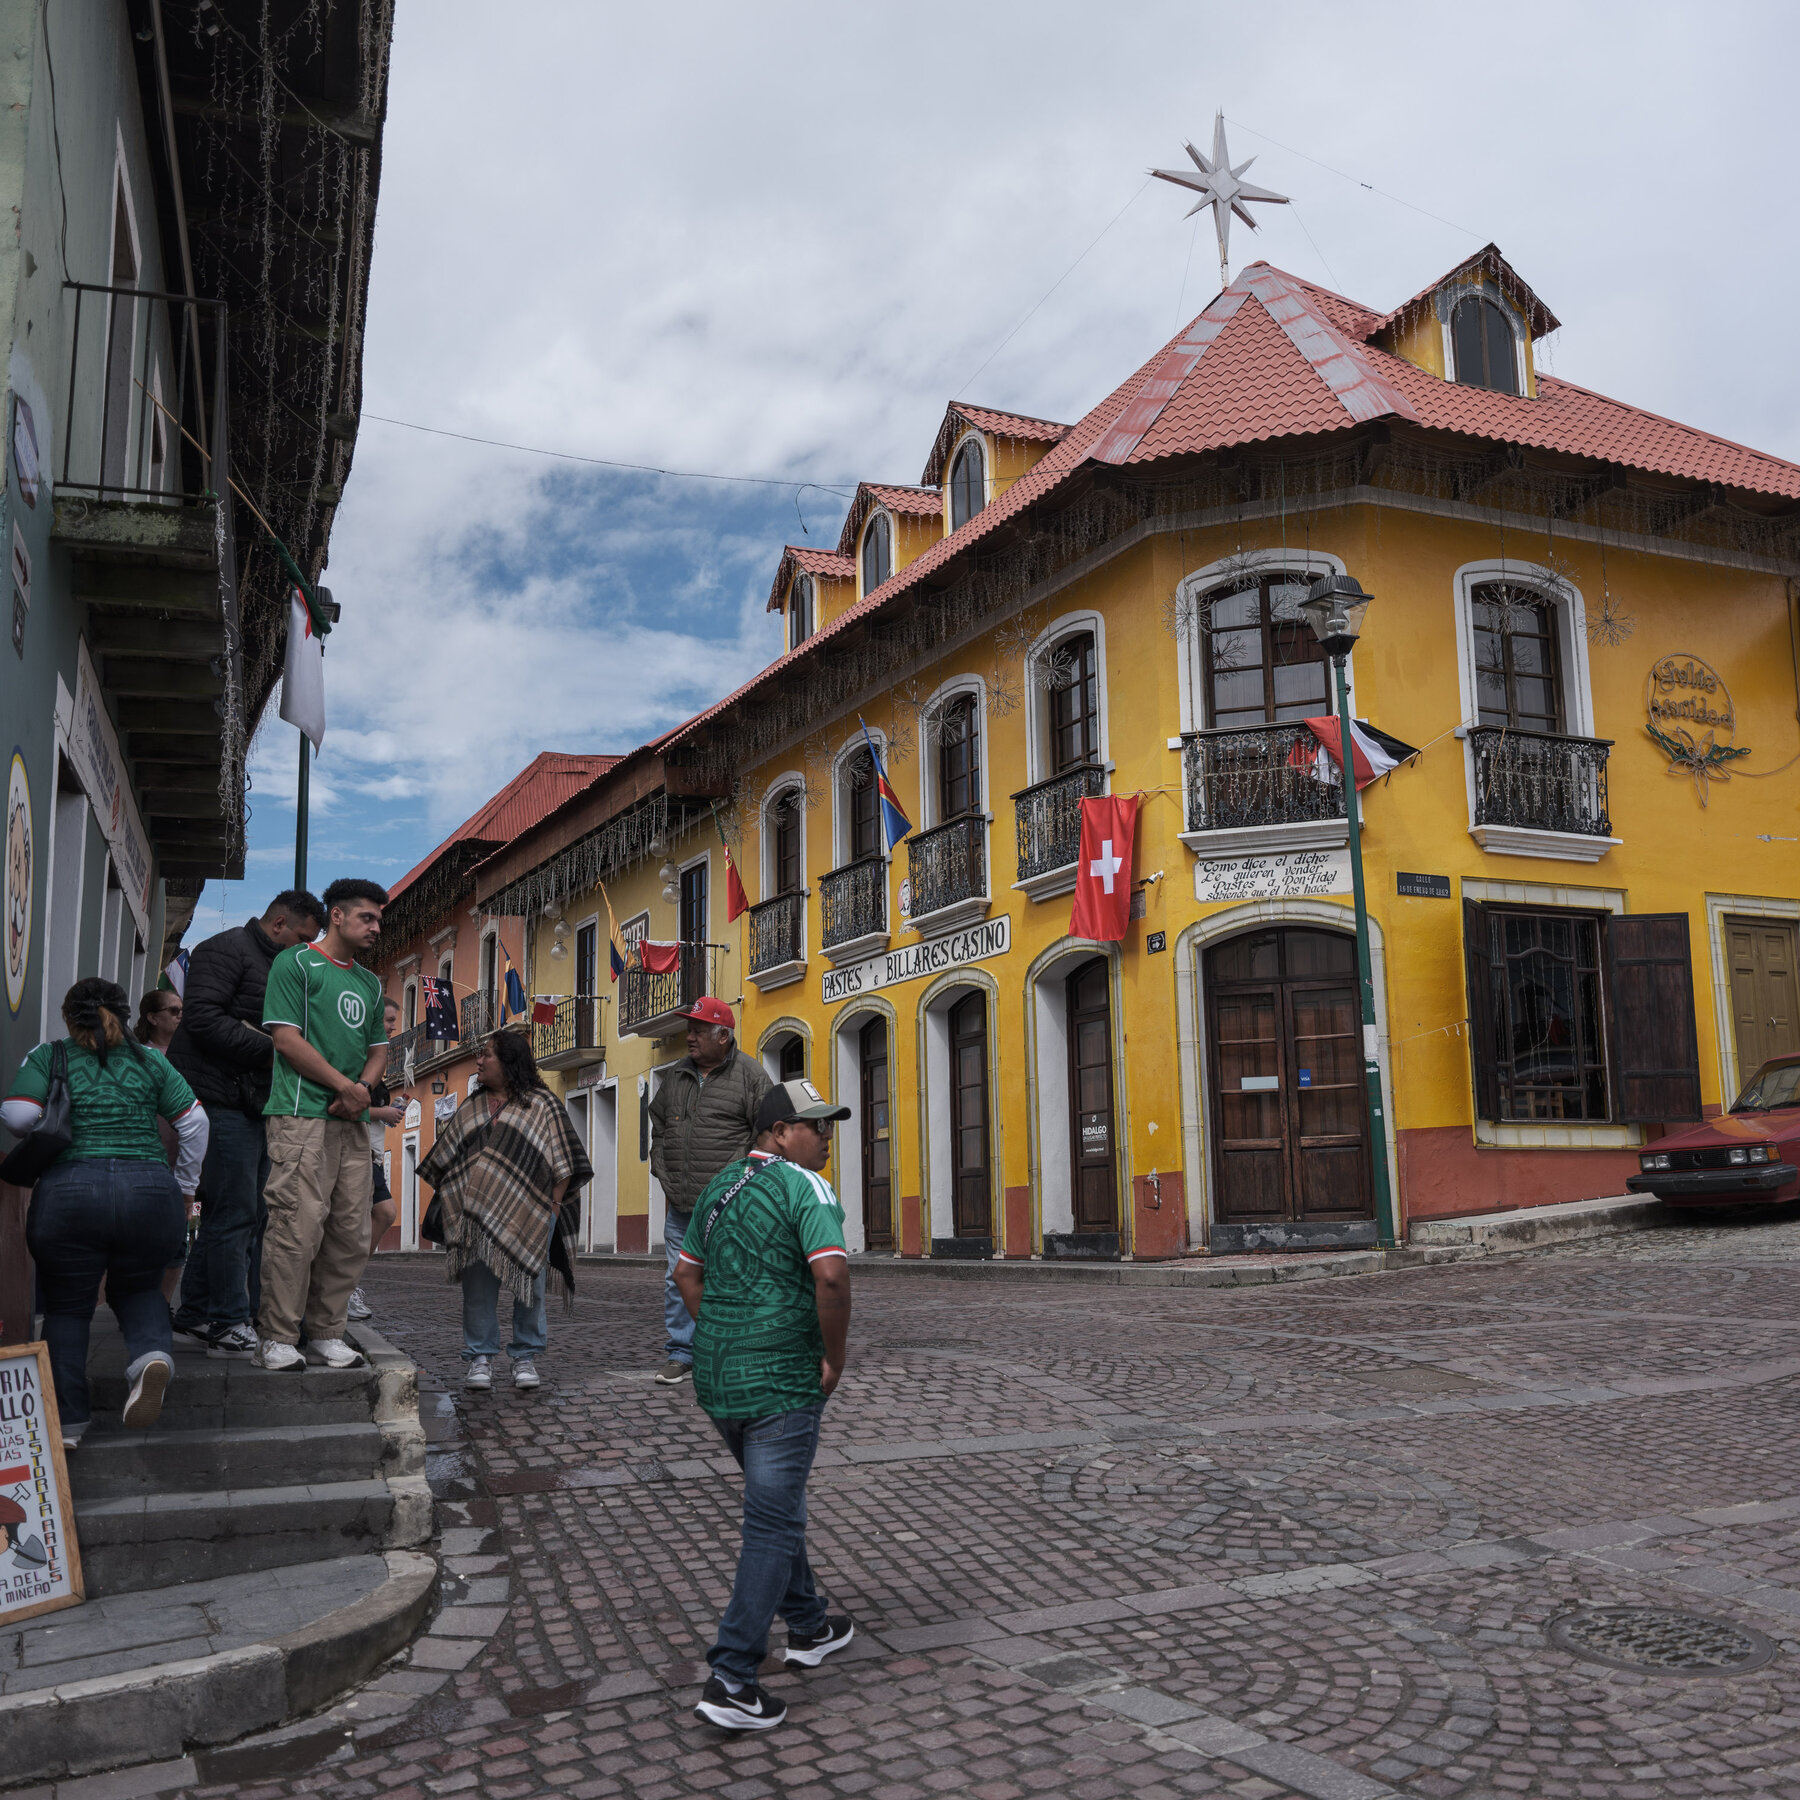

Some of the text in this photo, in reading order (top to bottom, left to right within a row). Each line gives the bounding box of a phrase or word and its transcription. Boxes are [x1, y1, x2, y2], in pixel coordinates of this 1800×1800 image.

[1241, 858, 1266, 870] dice
[1275, 855, 1287, 867] el
[1294, 852, 1330, 865] dicho:
[1201, 864, 1324, 883] Le quieren vender
[1212, 870, 1338, 893] Pastes a Don Fidel
[1415, 875, 1431, 884] CALLE
[1206, 888, 1248, 901] sabiendo
[1251, 888, 1267, 898] que
[1283, 885, 1300, 895] los
[1413, 886, 1428, 894] ENERO
[823, 966, 863, 999] PASTES
[885, 939, 950, 984] BILLARES
[951, 921, 1005, 963] CASINO
[343, 997, 360, 1021] 90
[1082, 1125, 1107, 1136] HIDALGO
[720, 1169, 756, 1204] LACOSTE
[25, 1417, 63, 1583] HISTORIA ARTES
[13, 1571, 42, 1588] DEL
[5, 1581, 51, 1604] MINERO
